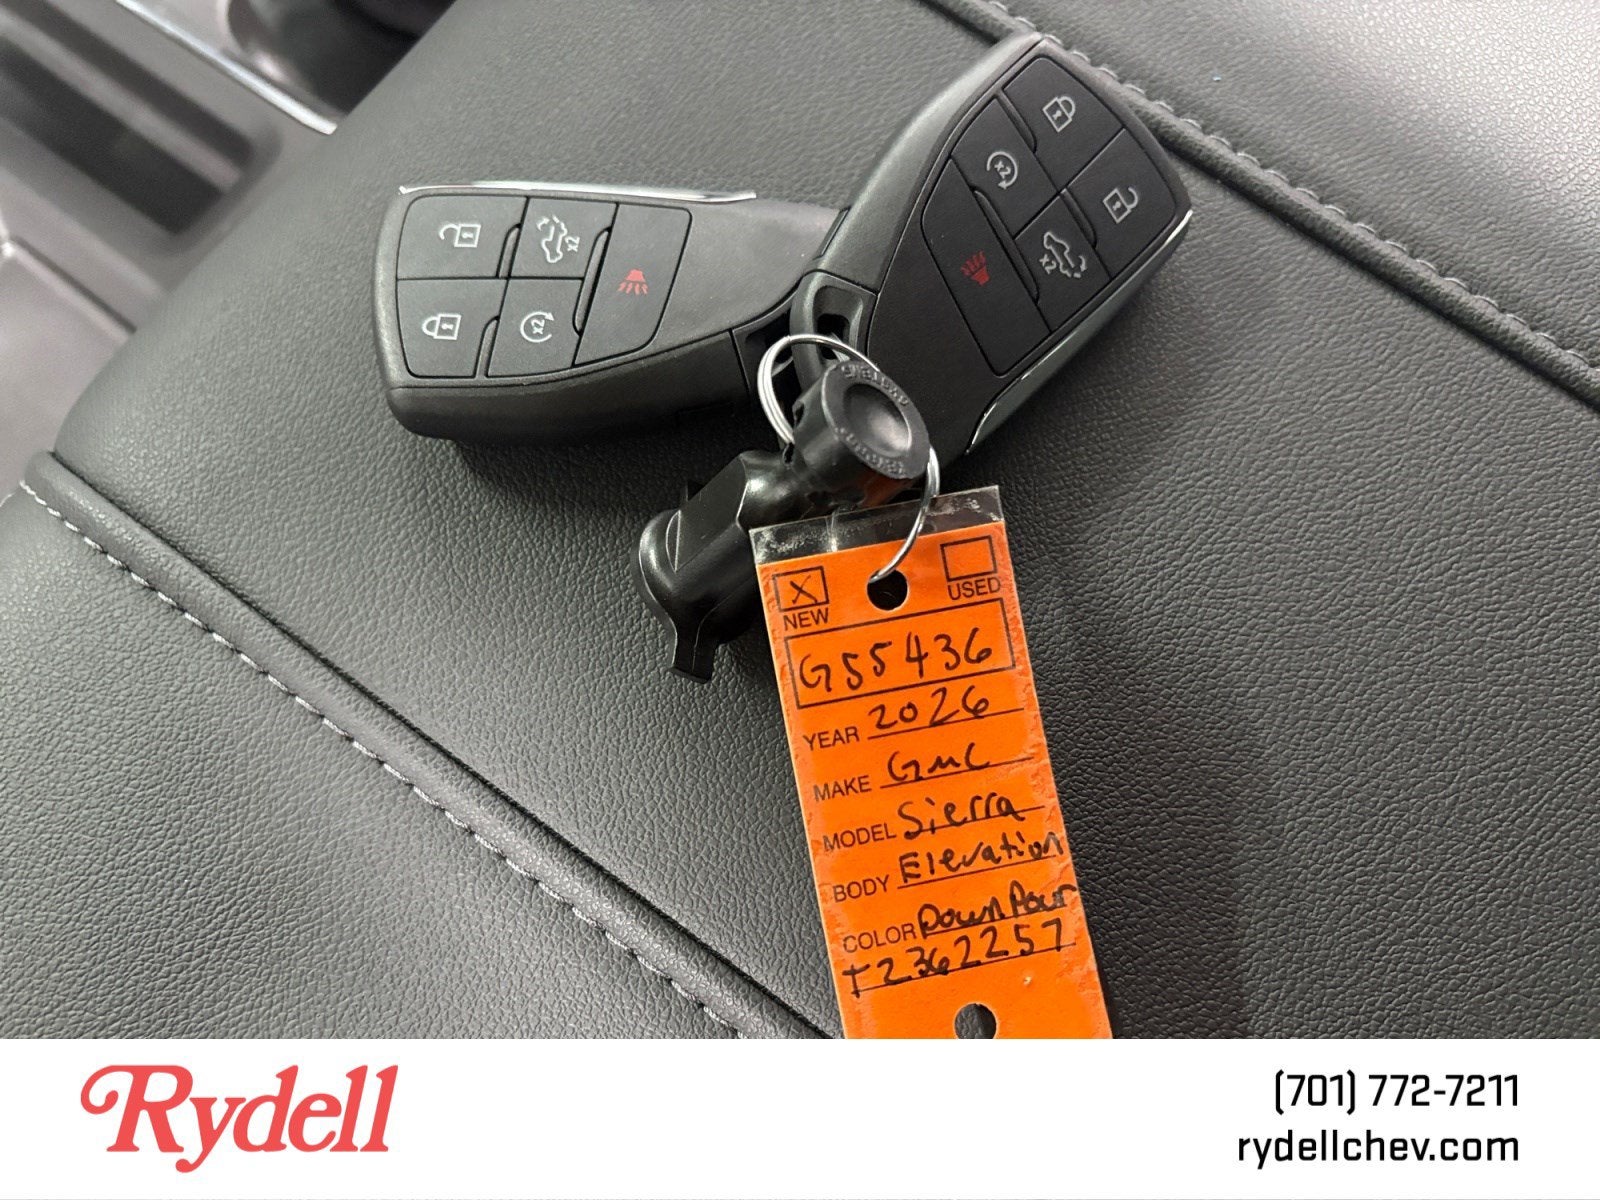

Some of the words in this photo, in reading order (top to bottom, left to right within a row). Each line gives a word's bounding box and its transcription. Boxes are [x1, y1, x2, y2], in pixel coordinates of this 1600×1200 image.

[947, 577, 1001, 601] USED
[783, 608, 830, 631] NEW
[799, 627, 993, 692] G55436
[867, 685, 989, 731] 2026
[803, 726, 860, 751] YEAR
[813, 775, 872, 802] MAKE
[897, 792, 1026, 840] Sierra
[823, 822, 897, 852] MODEL
[898, 830, 1065, 884] Elevation
[833, 874, 889, 902] BODY
[842, 922, 917, 954] COLOR
